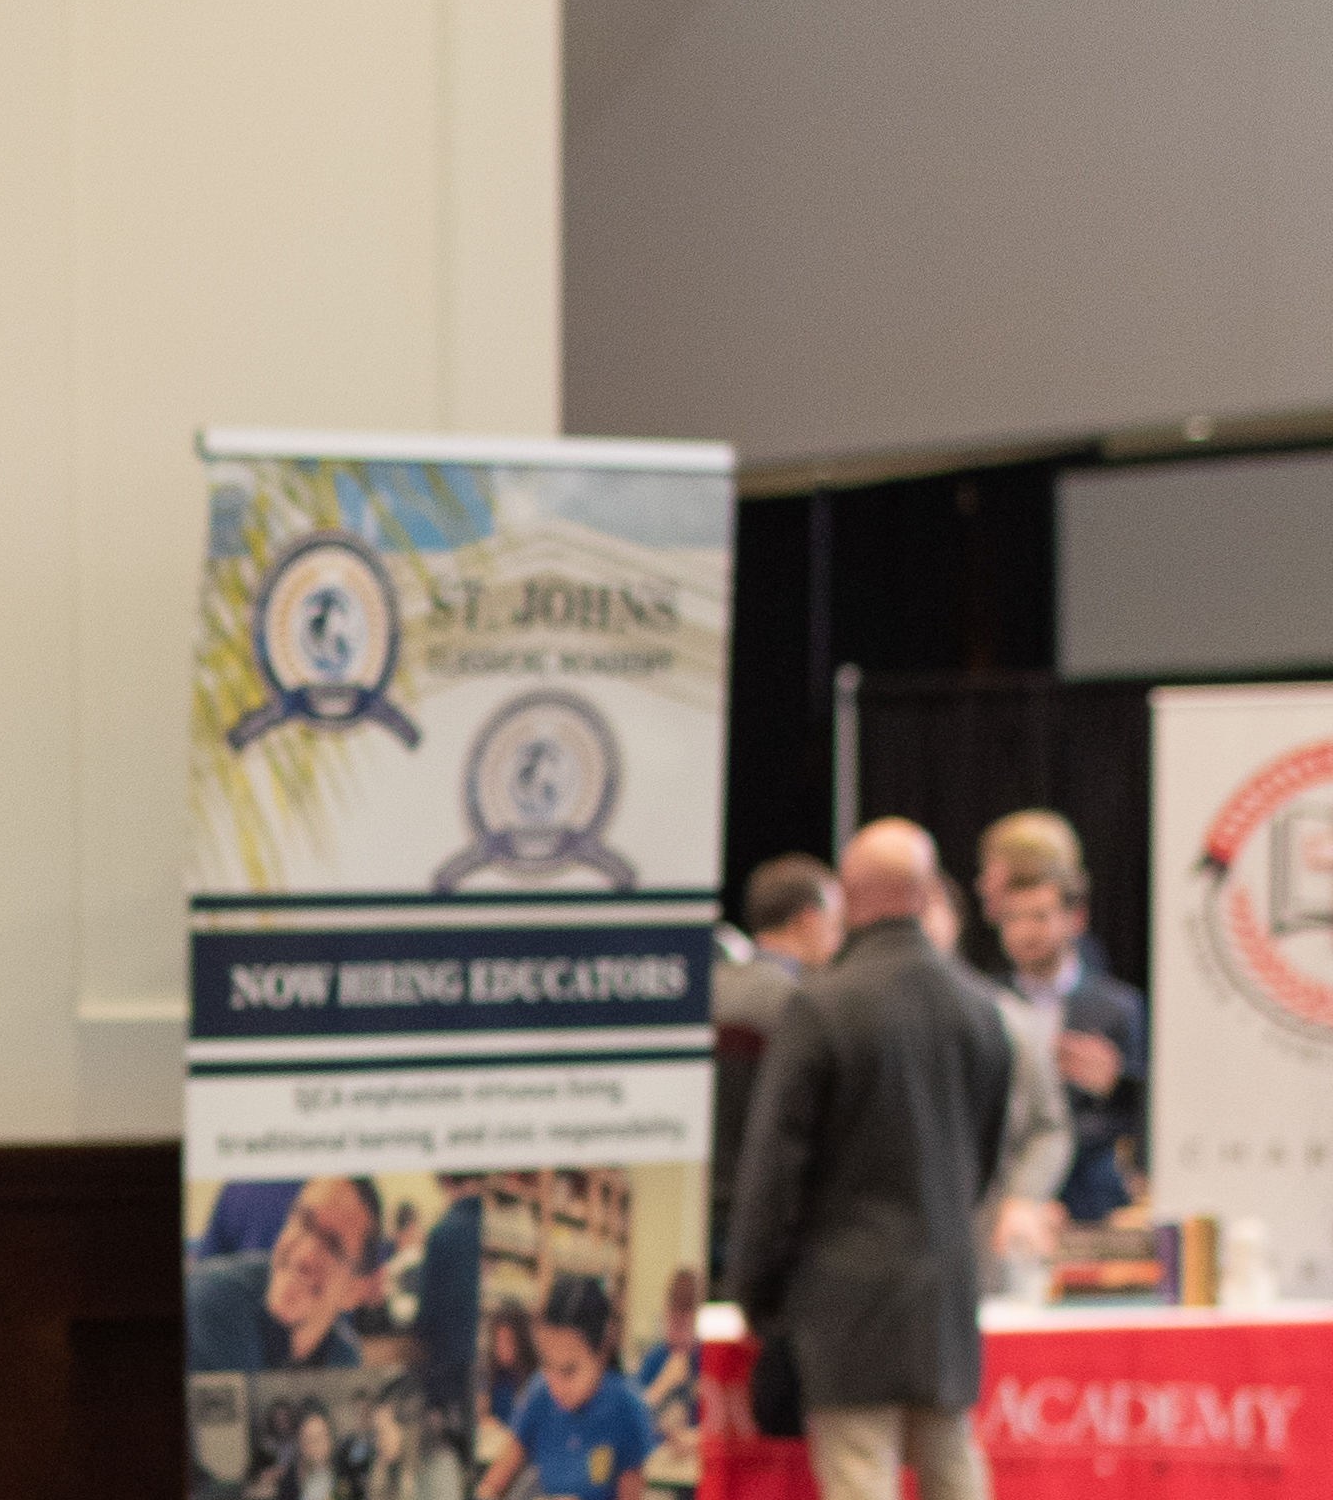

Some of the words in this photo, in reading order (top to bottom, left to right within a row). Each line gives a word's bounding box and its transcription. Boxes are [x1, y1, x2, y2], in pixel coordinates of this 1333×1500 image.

[228, 960, 332, 1012] NOW
[335, 957, 466, 1008] HIRING
[467, 952, 690, 1006] EDUCATORS
[979, 1374, 1304, 1452] ACADEMY
